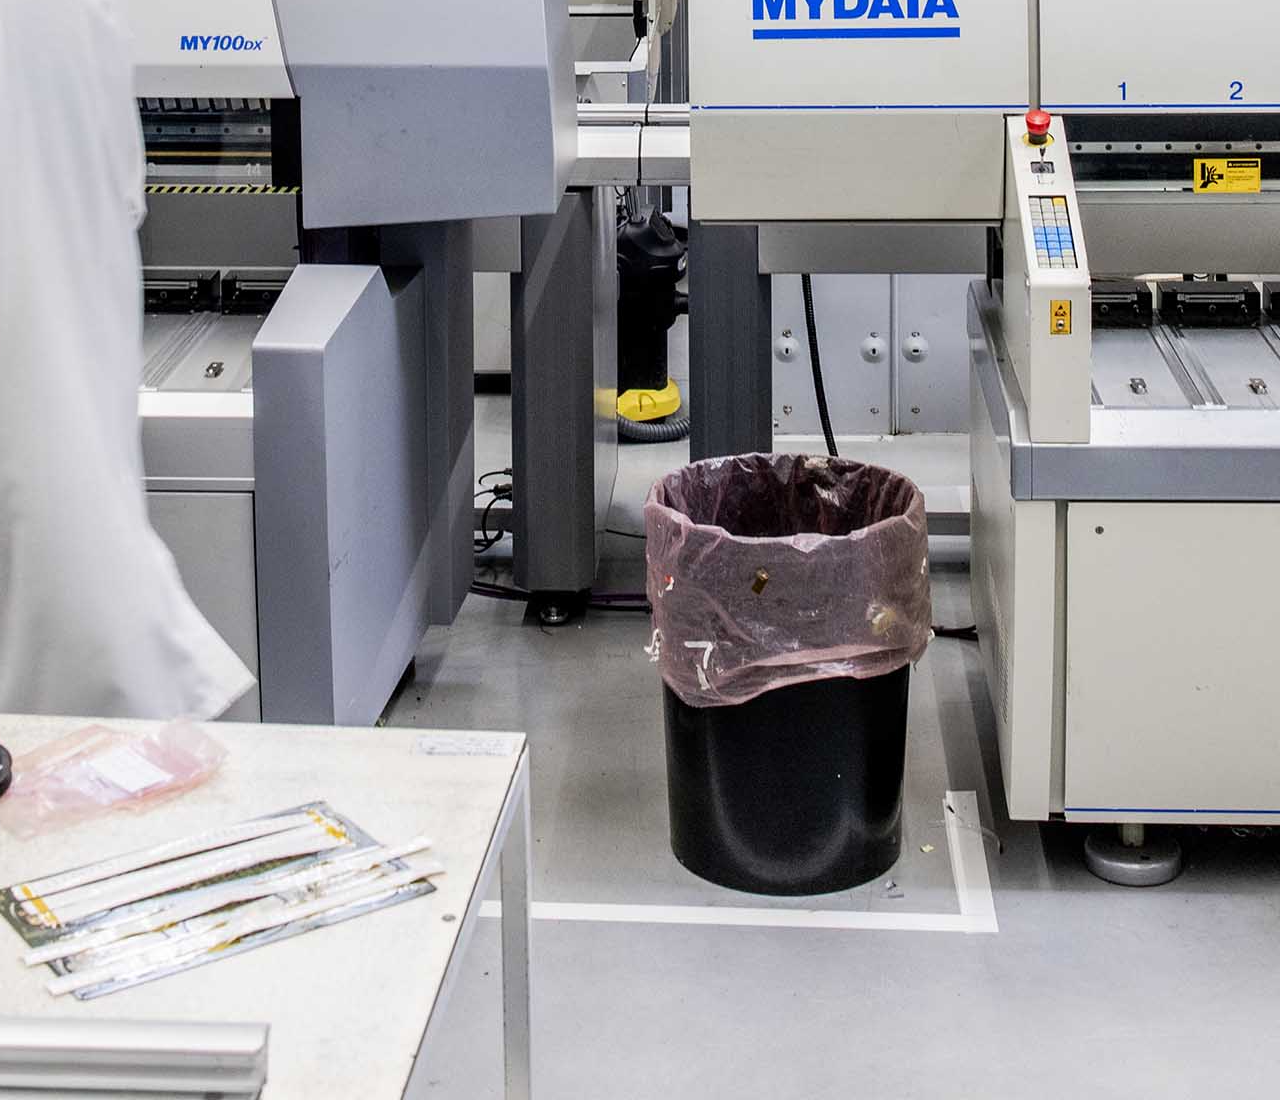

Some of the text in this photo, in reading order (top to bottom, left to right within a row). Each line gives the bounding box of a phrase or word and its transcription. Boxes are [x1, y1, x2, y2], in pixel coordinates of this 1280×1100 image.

[1117, 82, 1128, 101] 1
[1229, 81, 1244, 101] 2
[245, 163, 261, 177] 14
